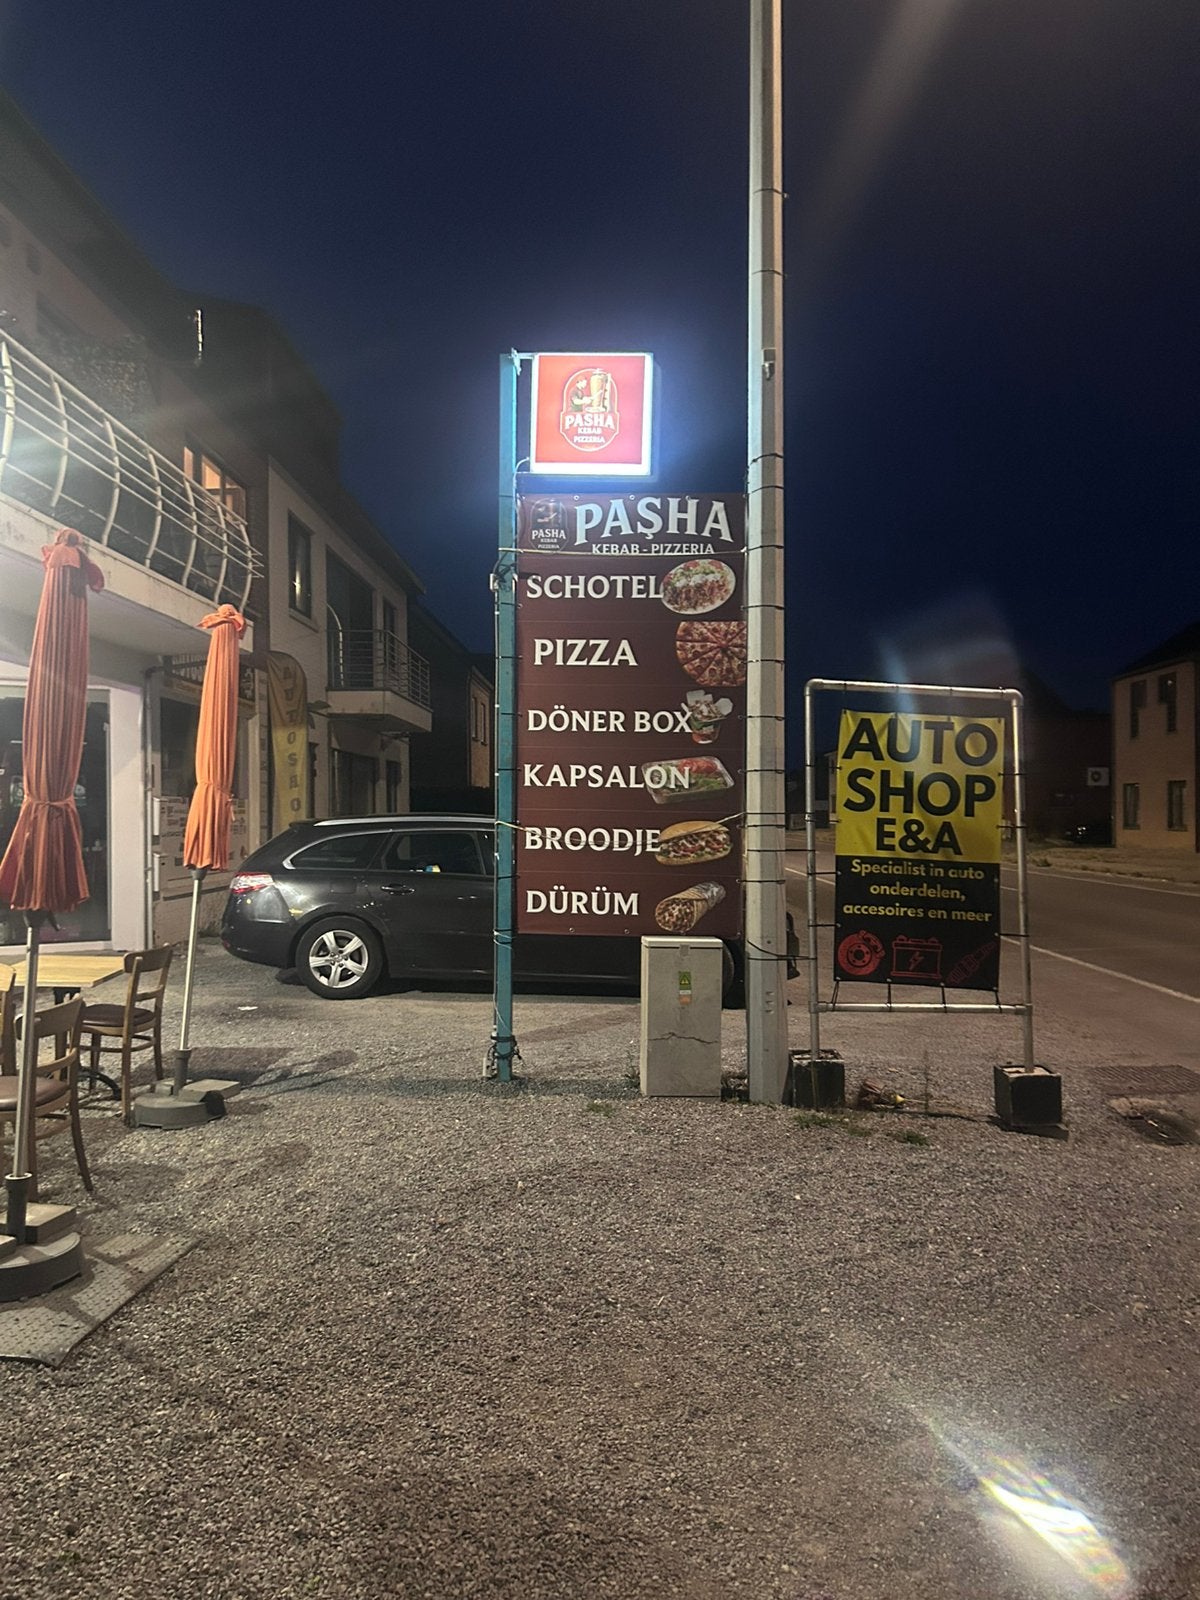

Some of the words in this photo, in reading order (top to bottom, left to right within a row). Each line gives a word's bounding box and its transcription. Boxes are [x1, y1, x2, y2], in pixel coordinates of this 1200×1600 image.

[565, 413, 616, 430] PASHA
[573, 435, 606, 443] PIZZERIA
[531, 528, 567, 540] PASHA
[574, 496, 734, 546] PAŞHA
[592, 543, 640, 555] KEBAB
[651, 543, 715, 555] PIZZERIA
[526, 575, 664, 599] SCHOTEL
[534, 638, 638, 666] PIZZA
[527, 704, 626, 733] DÖNER
[634, 710, 693, 733] BOX
[841, 717, 998, 767] AUTO
[523, 763, 691, 789] KAPSALON
[843, 767, 996, 818] SHOP
[524, 827, 662, 857] BROODJE
[876, 817, 963, 856] E&A
[851, 858, 926, 876] Specialist
[929, 863, 944, 877] in
[948, 866, 985, 880] auto
[526, 885, 639, 916] DÜRÜM
[869, 881, 966, 901] onderdelen,
[843, 902, 924, 918] accesoires
[927, 908, 947, 920] en
[951, 909, 993, 922] meer
